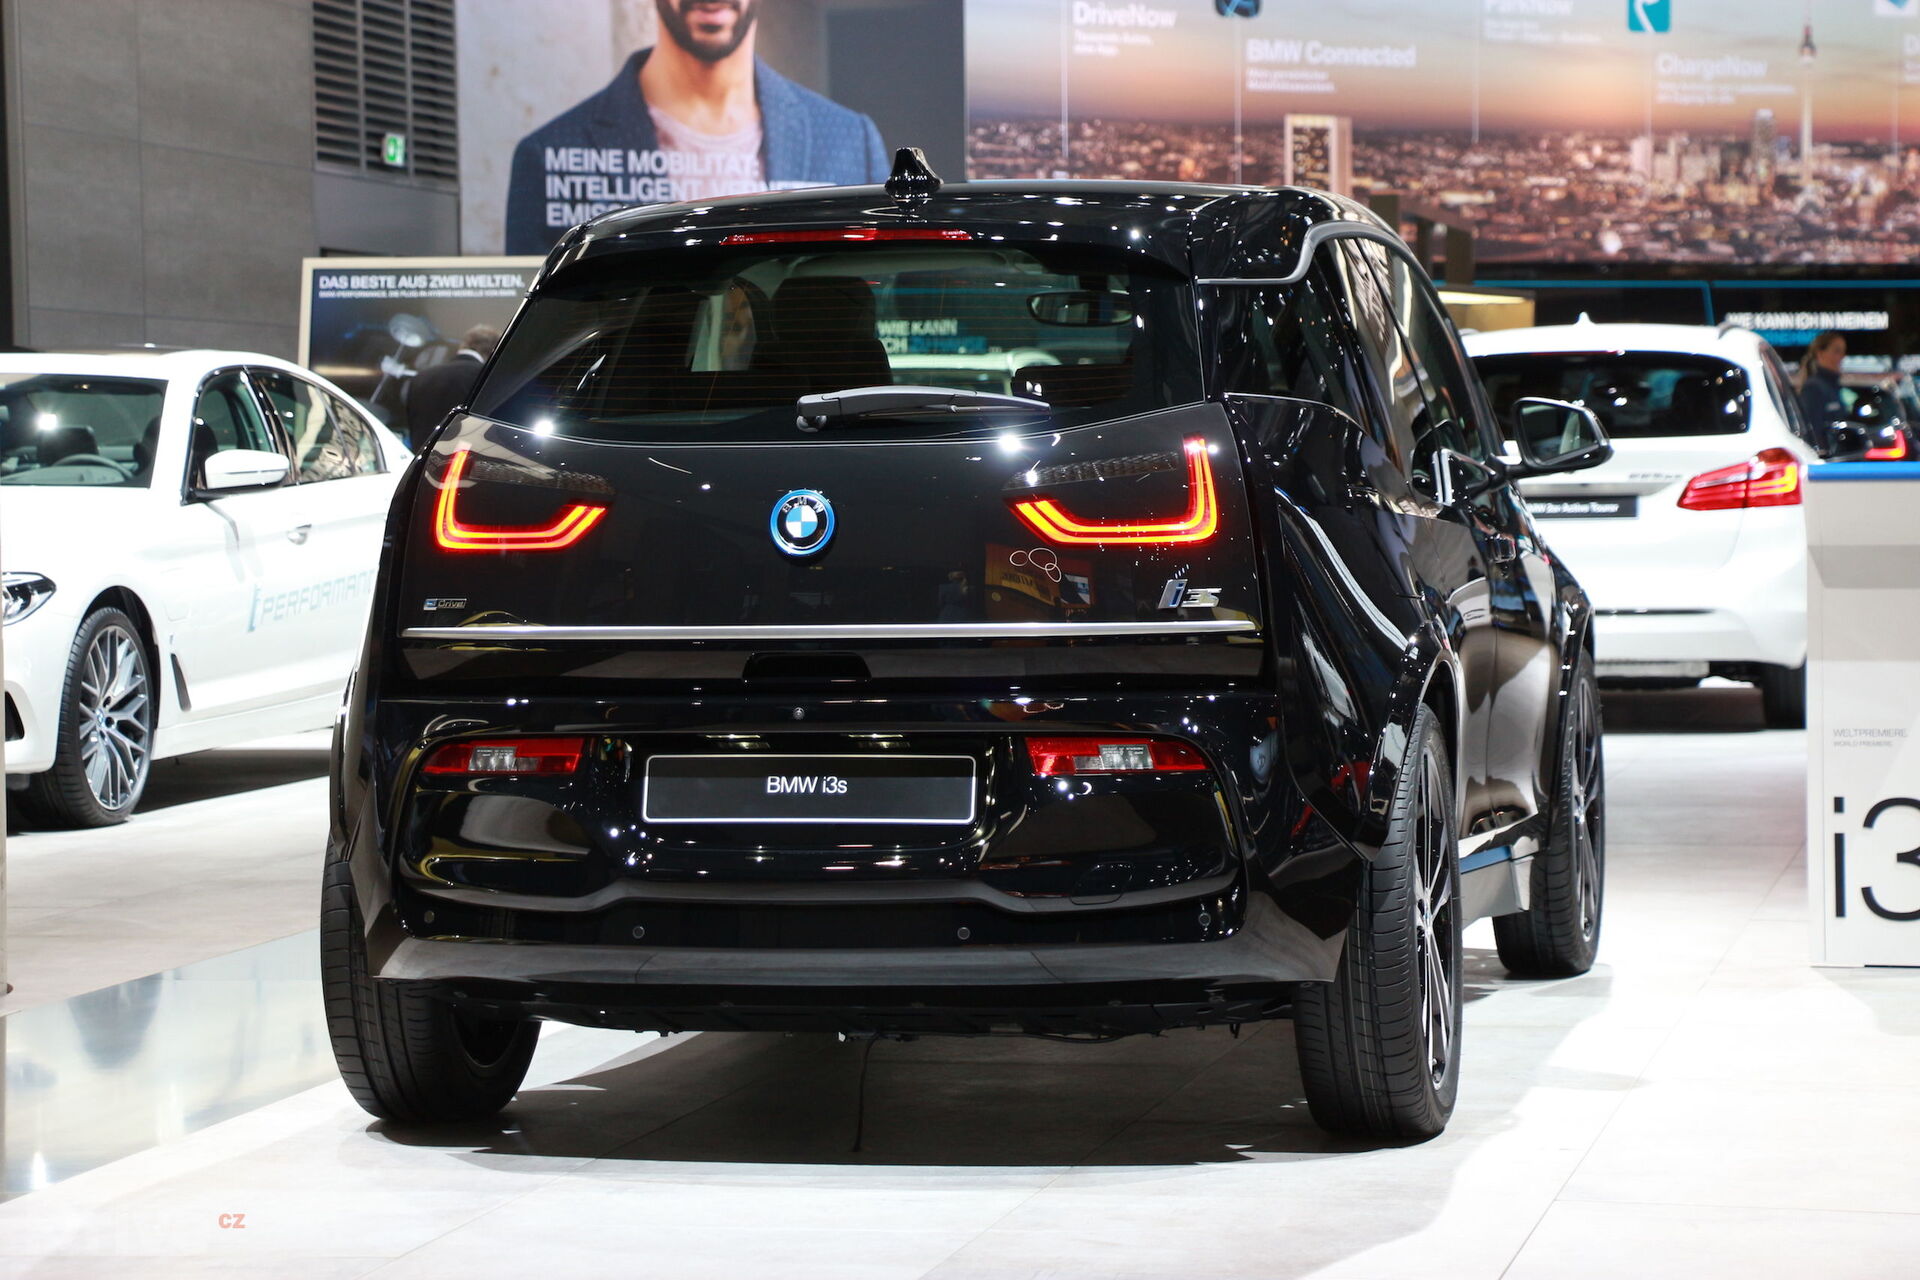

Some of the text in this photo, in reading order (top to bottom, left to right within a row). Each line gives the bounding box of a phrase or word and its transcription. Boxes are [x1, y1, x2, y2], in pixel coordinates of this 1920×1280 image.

[1073, 1, 1177, 27] DriveNow
[1247, 38, 1417, 67] BMW Connected
[1656, 52, 1768, 80] ChargeNow
[545, 147, 625, 173] MEINE
[545, 175, 703, 202] INTELLIGENT
[319, 274, 526, 289] DAS BESTE AUS ZWEI WELTEN.
[911, 318, 958, 336] KANN
[1754, 311, 1794, 329] KANN
[1795, 312, 1818, 329] ICH
[1820, 312, 1834, 329] IN
[1835, 311, 1888, 329] MEINEM
[782, 495, 825, 514] BMW
[1561, 503, 1589, 513] Active
[1589, 502, 1619, 513] Tourer
[1833, 728, 1908, 738] WELTPREMIERE
[767, 776, 848, 794] BMW i3s
